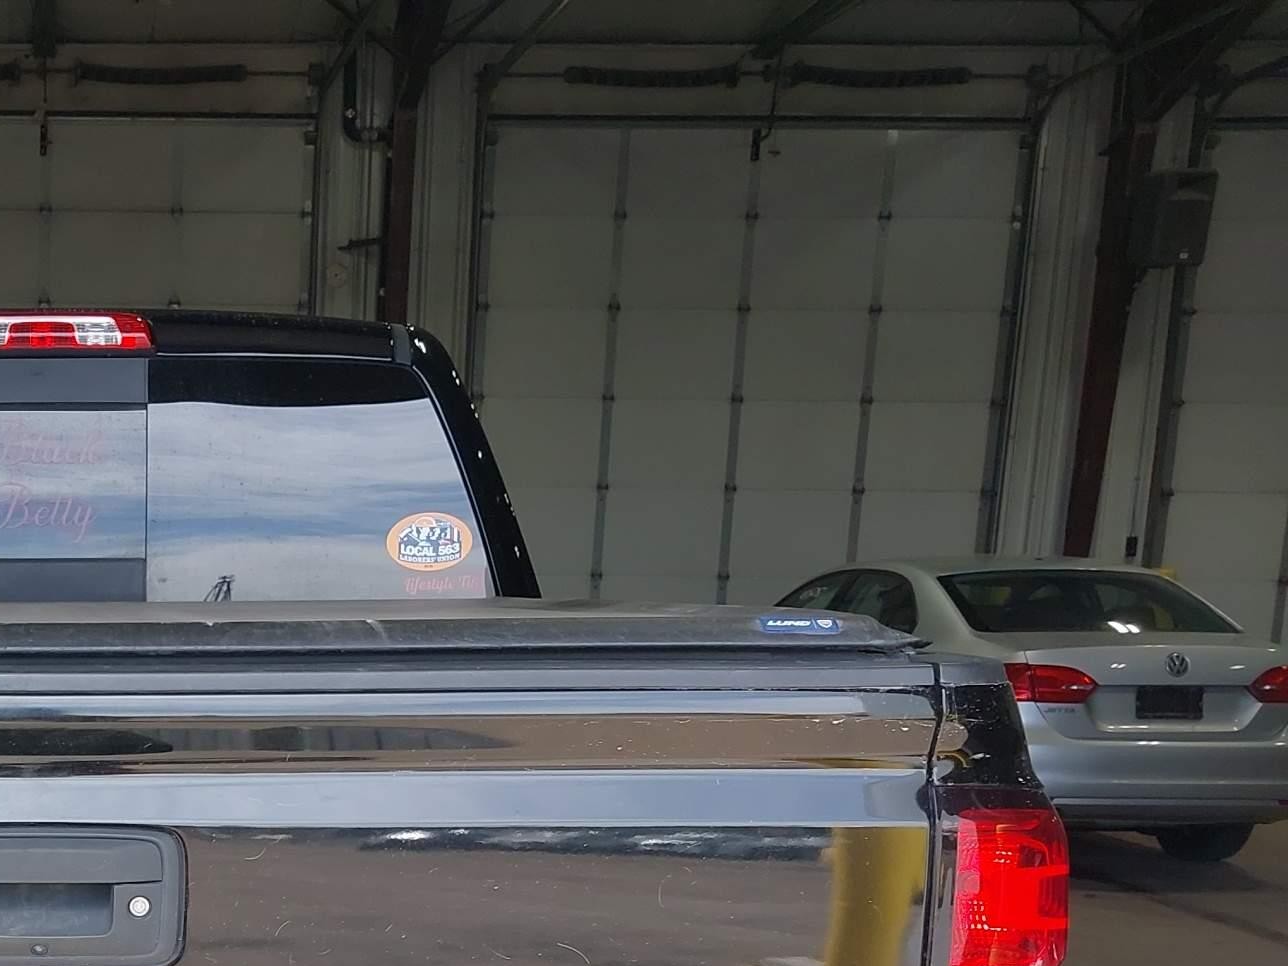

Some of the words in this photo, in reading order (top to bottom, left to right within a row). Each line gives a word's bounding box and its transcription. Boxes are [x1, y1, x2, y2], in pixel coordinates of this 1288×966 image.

[400, 543, 436, 557] LOCAL
[438, 542, 460, 555] 563
[766, 619, 812, 627] LUND
